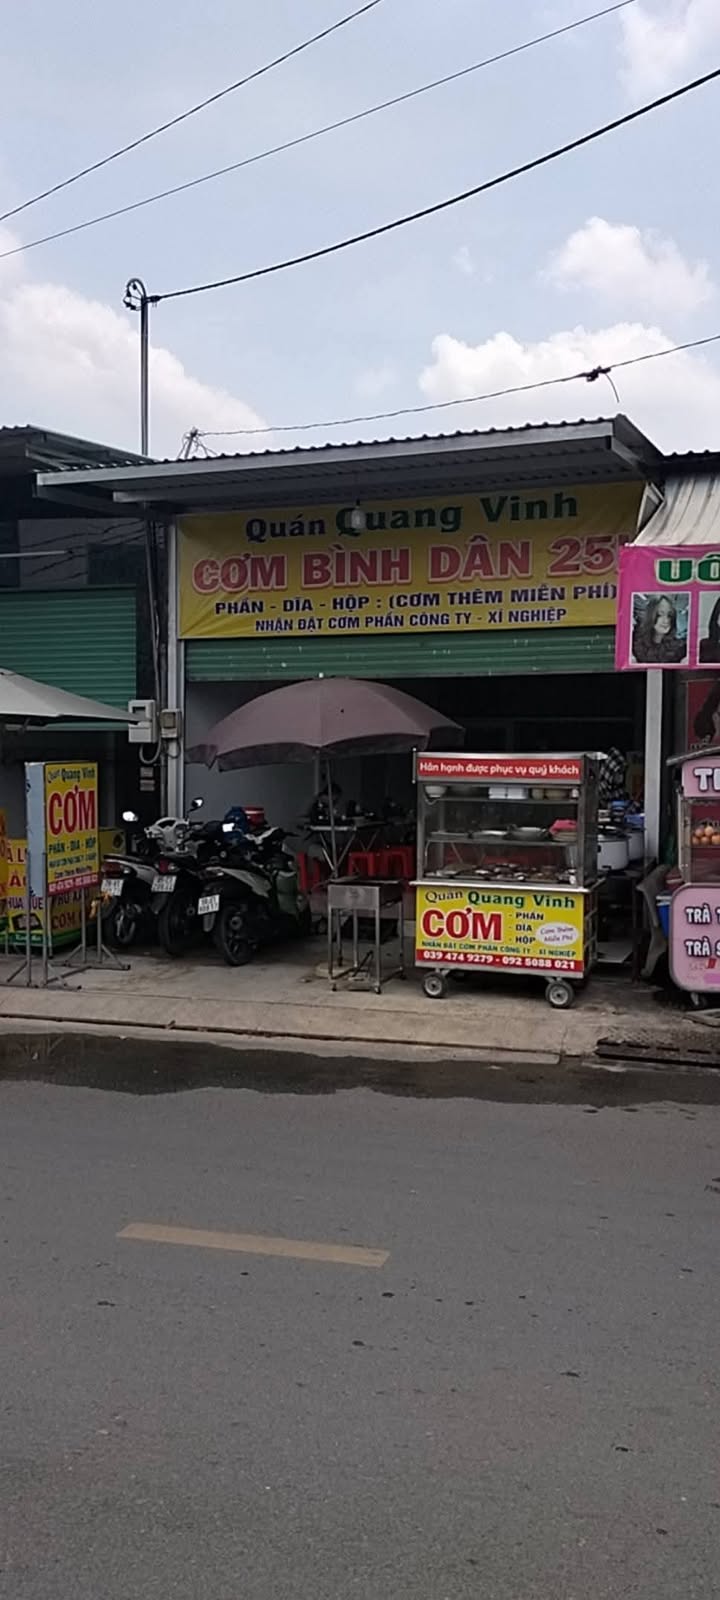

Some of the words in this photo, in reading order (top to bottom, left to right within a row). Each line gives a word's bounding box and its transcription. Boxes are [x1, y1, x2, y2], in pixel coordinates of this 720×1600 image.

[246, 513, 326, 542] Quán
[335, 504, 464, 537] Quang
[479, 491, 578, 523] Vinh
[192, 552, 288, 594] CƠM
[301, 544, 412, 589] BÌNH
[428, 534, 533, 583] DÂN
[332, 594, 369, 612] HỘP
[447, 588, 503, 606] THÊM
[255, 617, 293, 633] NHẬN
[328, 615, 360, 629] CƠM
[409, 610, 450, 627] CÔNG
[455, 612, 472, 625] TY
[508, 605, 568, 625] NGHIỆP
[440, 763, 465, 774] hạnh
[465, 763, 488, 774] được
[490, 765, 514, 775] phục
[515, 766, 527, 775] vụ
[549, 766, 579, 775] khách
[49, 785, 97, 836] CƠM
[467, 891, 525, 908] Quang
[533, 894, 576, 909] Vinh
[421, 907, 504, 942] CƠM
[684, 902, 712, 925] TRÀ
[684, 935, 712, 957] TRÀ
[423, 950, 443, 960] 039
[502, 956, 522, 965] 092
[555, 960, 575, 969] 021
